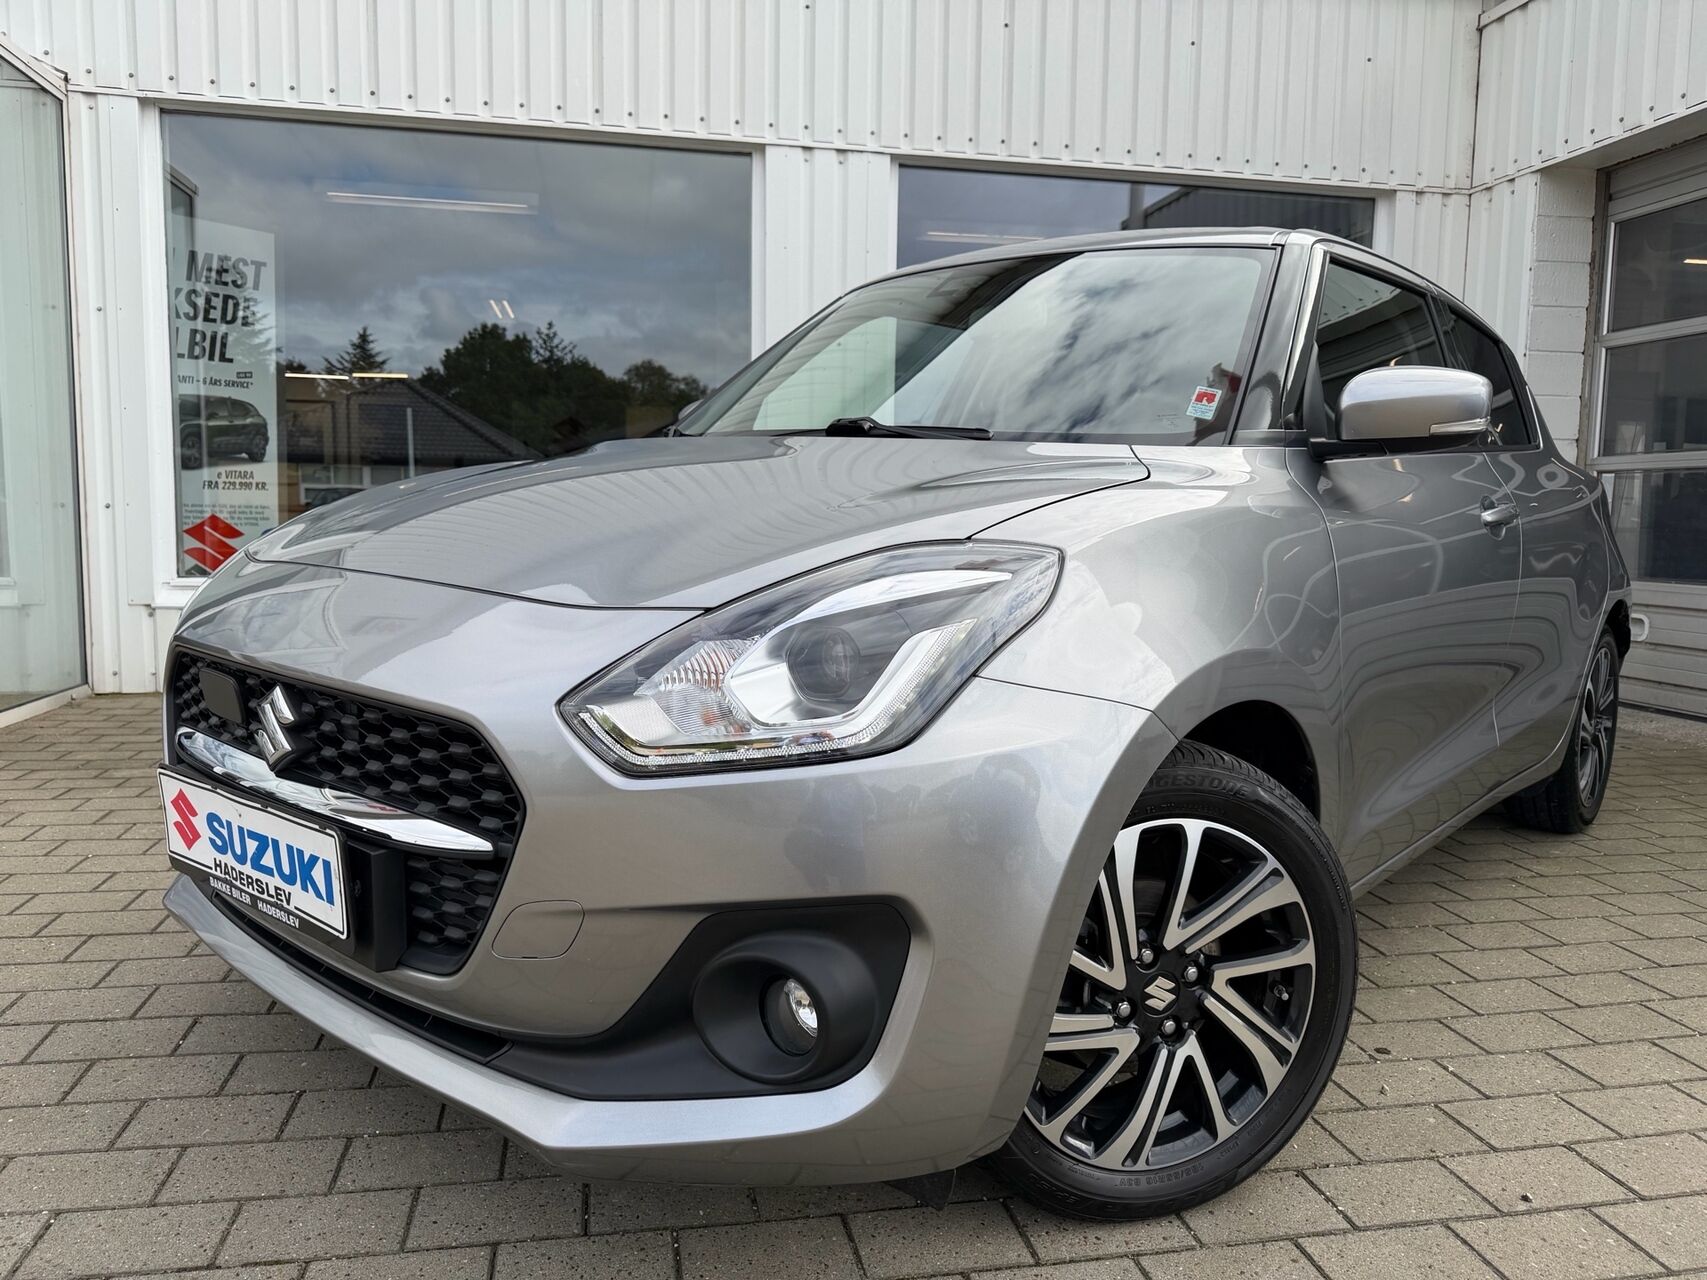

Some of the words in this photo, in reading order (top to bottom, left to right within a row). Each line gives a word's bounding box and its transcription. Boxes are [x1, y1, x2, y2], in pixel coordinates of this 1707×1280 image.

[185, 249, 267, 291] MEST
[202, 480, 219, 490] FRA
[222, 480, 253, 491] 229.990
[225, 470, 254, 480] VITARA
[206, 812, 334, 906] SUZUKI
[213, 857, 292, 907] HADERSLEV
[209, 876, 231, 895] BAKKE
[231, 886, 252, 905] BILER
[257, 899, 299, 929] HADERSLEV
